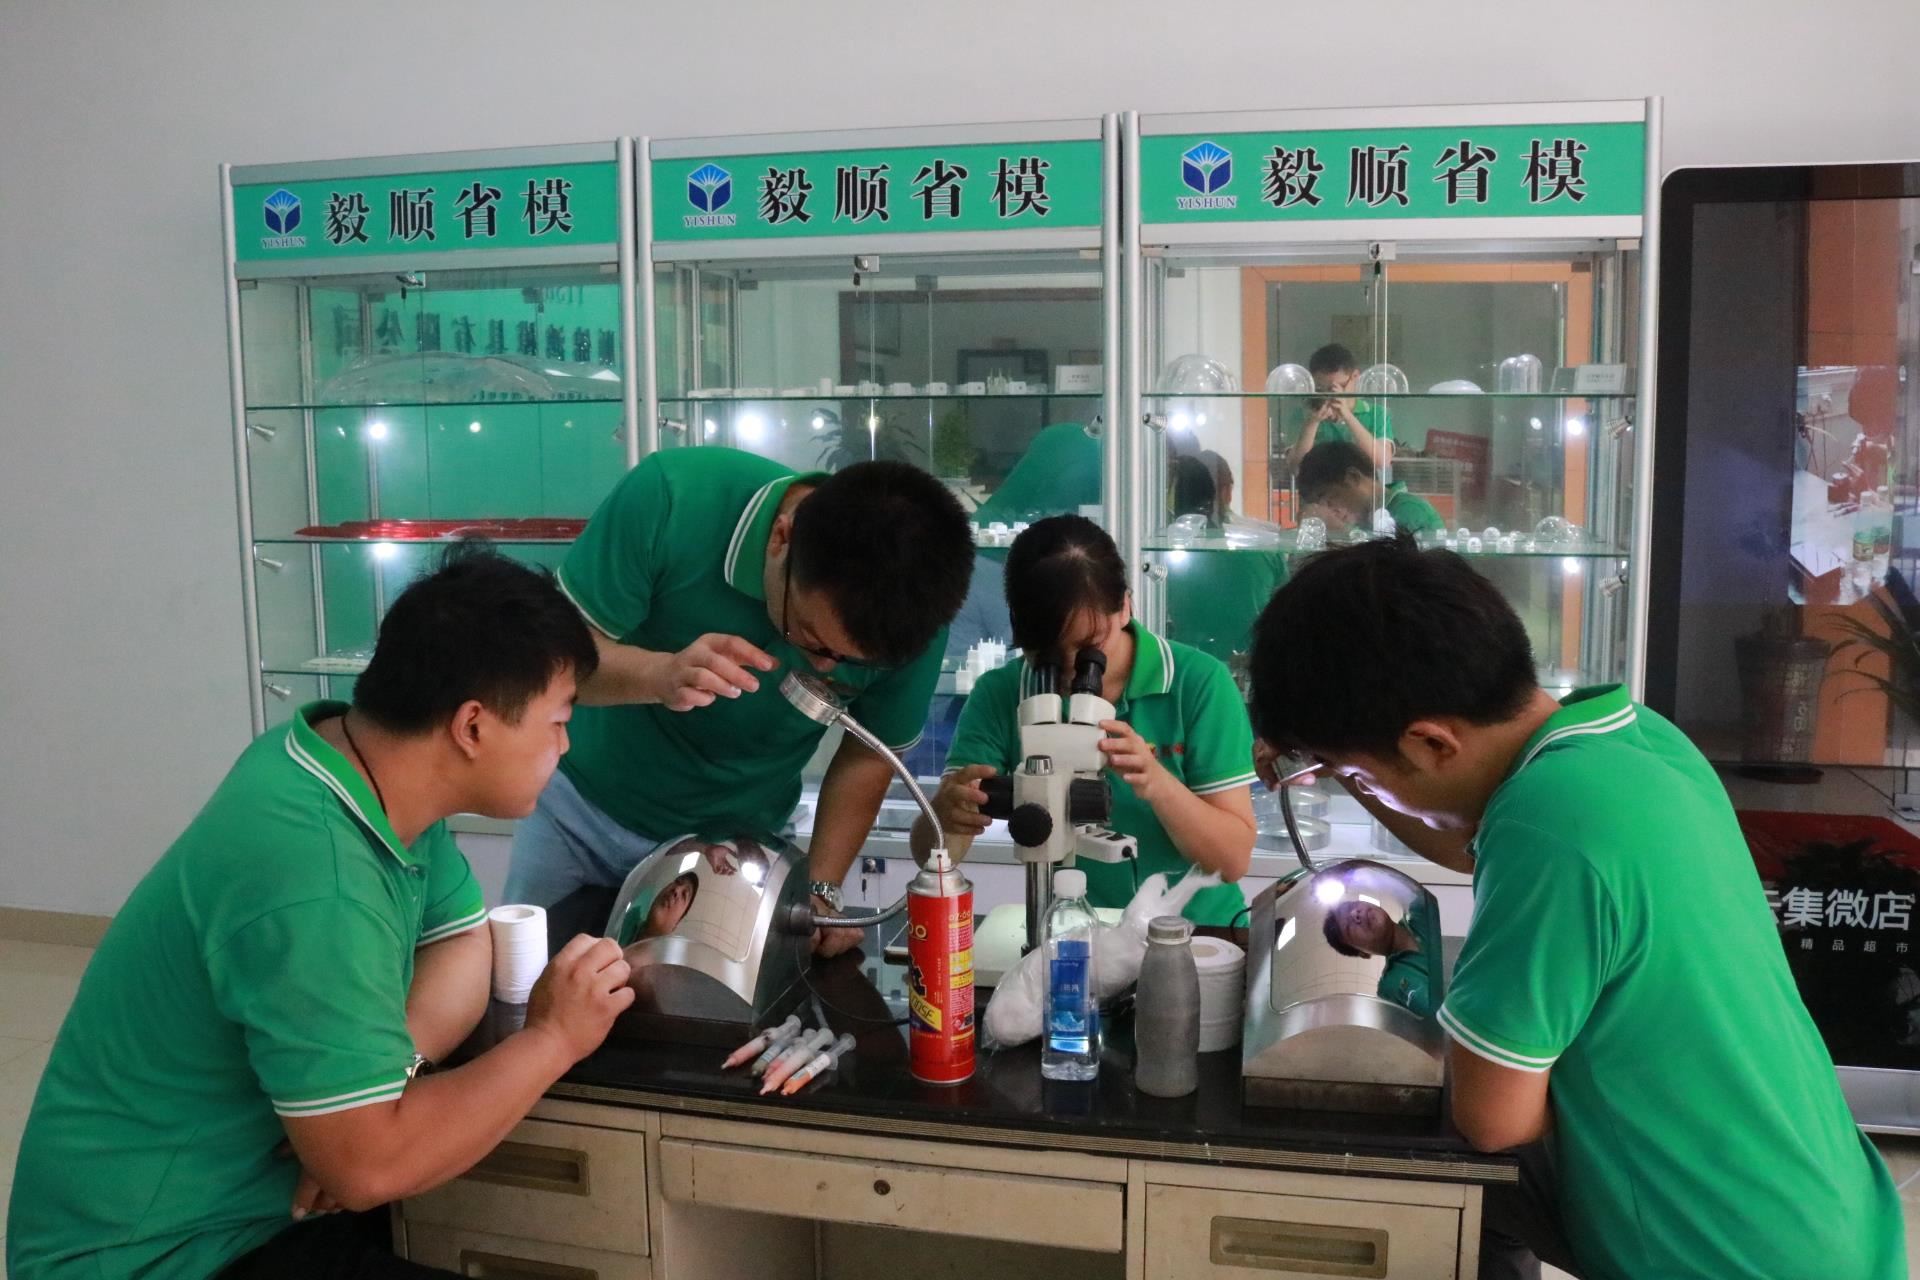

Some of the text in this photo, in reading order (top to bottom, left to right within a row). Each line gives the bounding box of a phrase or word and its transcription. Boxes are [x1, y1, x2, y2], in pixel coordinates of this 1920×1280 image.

[1262, 139, 1588, 208] 毅顺省模
[758, 155, 1051, 224] 毅顺省模
[1177, 195, 1237, 210] YISHUN
[325, 179, 573, 244] 毅顺省模
[684, 214, 736, 227] YISHUN
[262, 235, 306, 248] YISHUN
[1801, 938, 1908, 953] 精品超市
